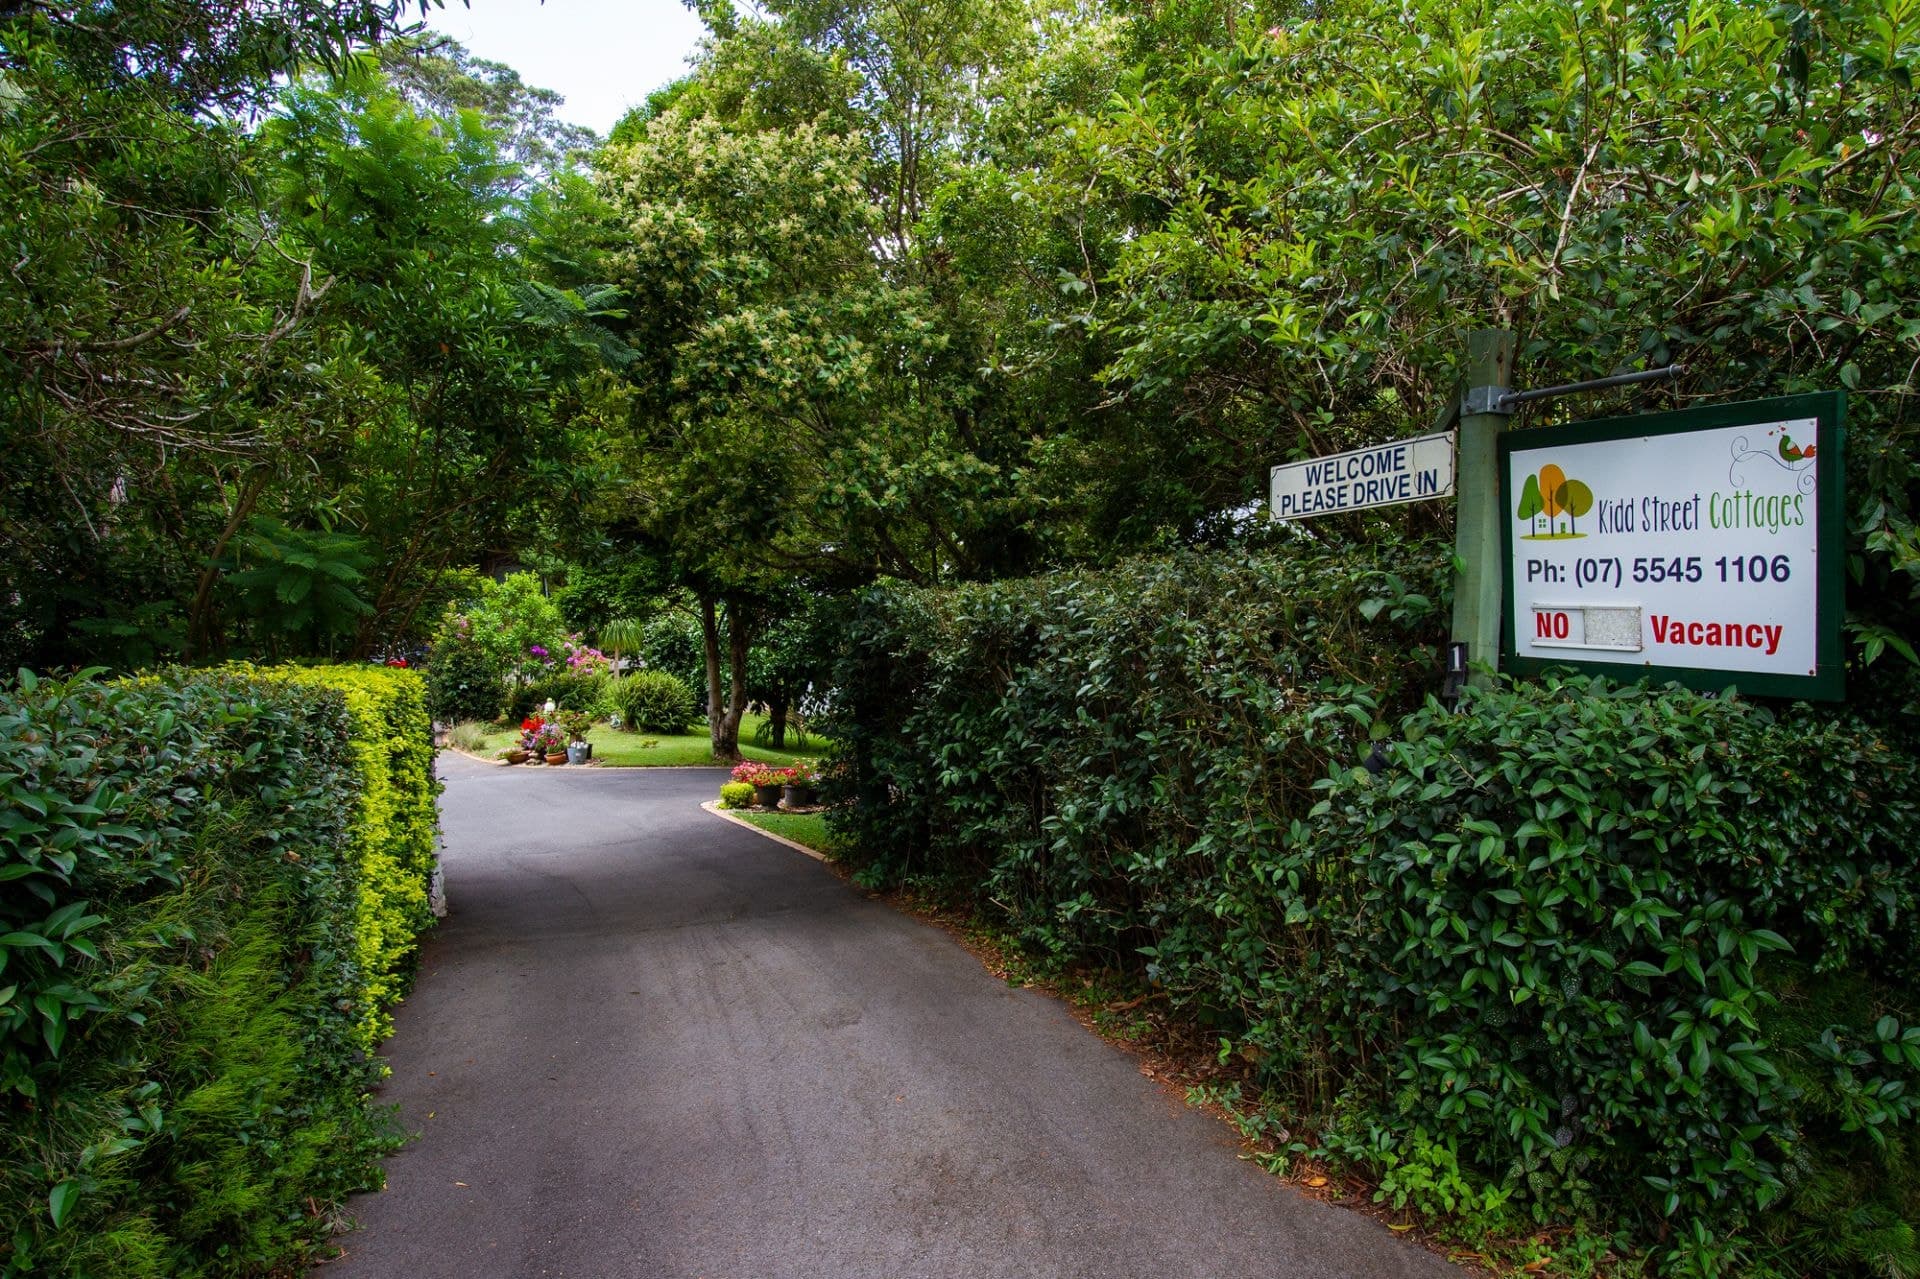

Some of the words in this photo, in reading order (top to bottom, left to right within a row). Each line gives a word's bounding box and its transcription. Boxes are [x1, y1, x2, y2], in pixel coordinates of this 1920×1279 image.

[1305, 447, 1406, 487] WELCOME
[1281, 485, 1348, 515] PLEASE
[1353, 473, 1411, 505] DRIVE
[1417, 468, 1438, 495] IN
[1599, 498, 1634, 534] Kidd
[1709, 490, 1804, 534] Cottages
[1527, 559, 1565, 582] Ph:
[1575, 557, 1622, 588] (07)
[1632, 556, 1702, 583] 5545
[1715, 554, 1791, 583] 1106
[1536, 612, 1569, 639] NO
[1650, 615, 1783, 655] Vacancy
